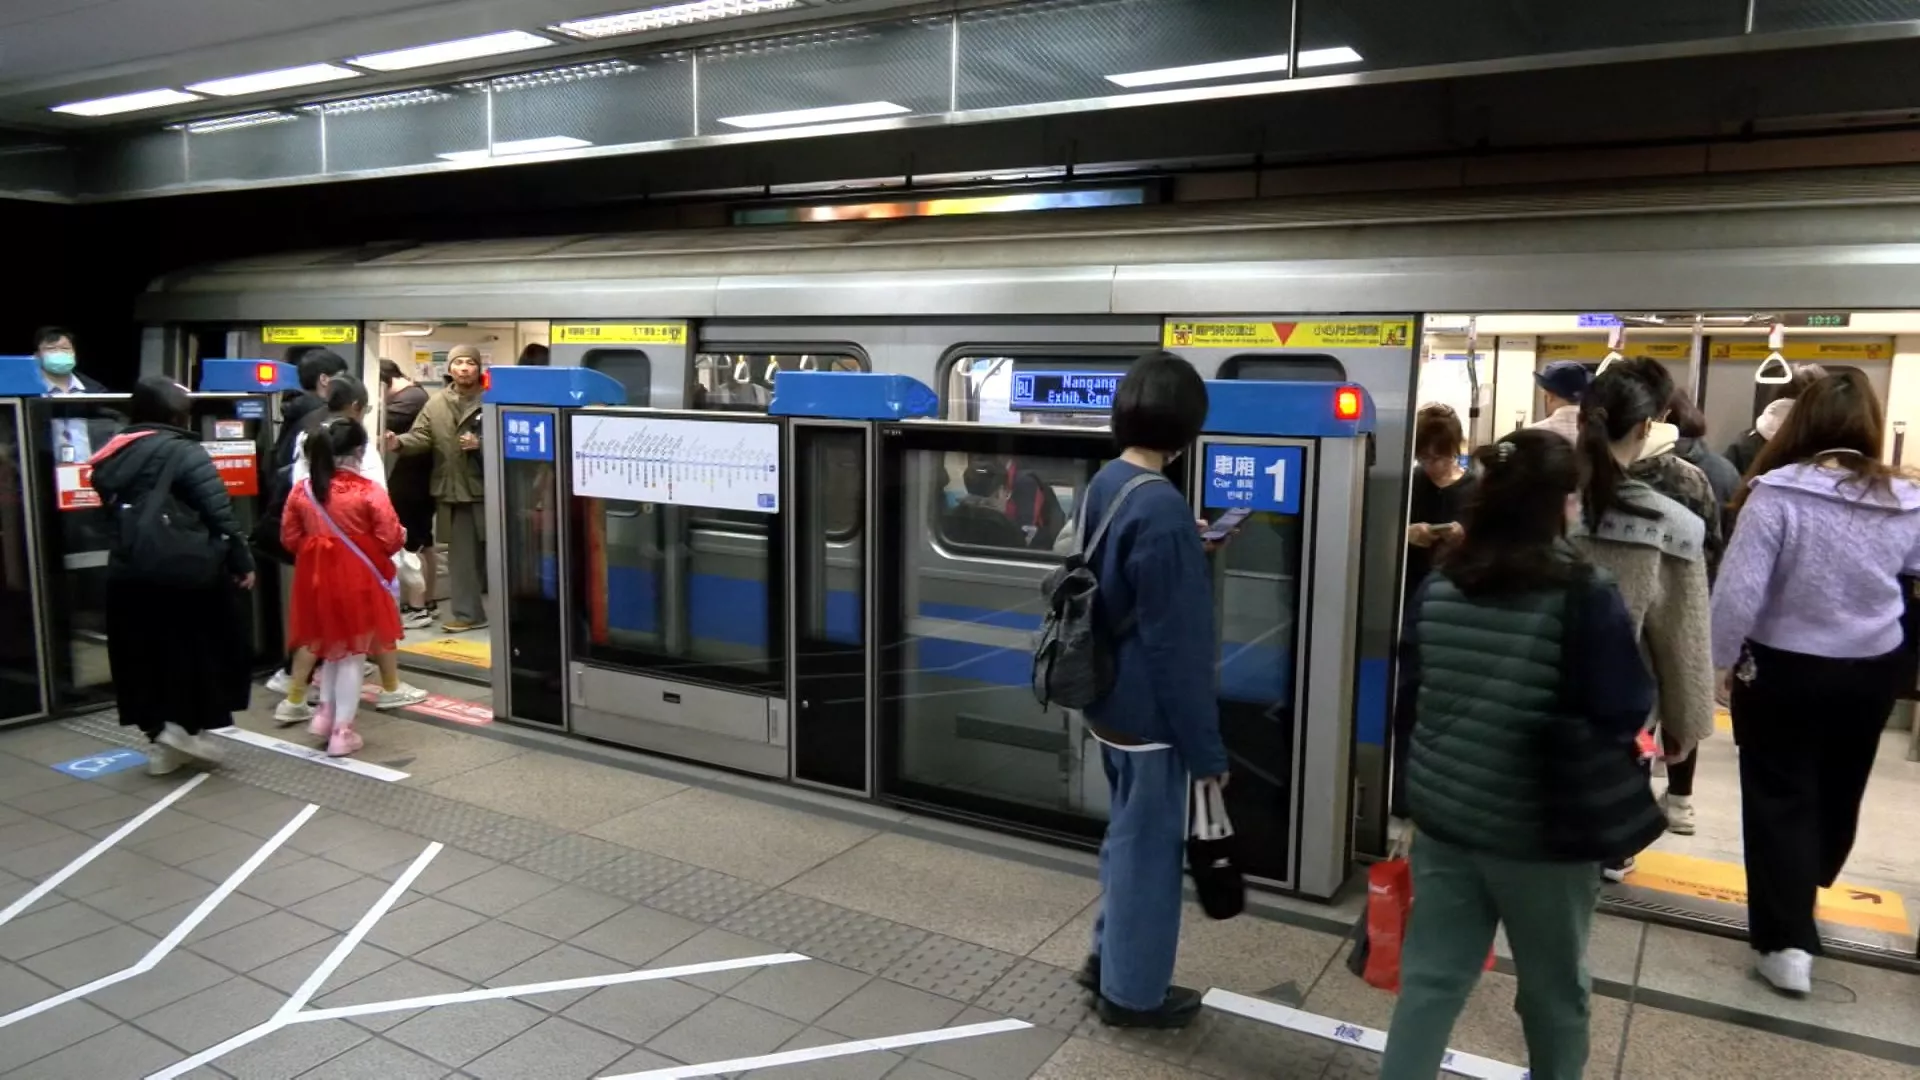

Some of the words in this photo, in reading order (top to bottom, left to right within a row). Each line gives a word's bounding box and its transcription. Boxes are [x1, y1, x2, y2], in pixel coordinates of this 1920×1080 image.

[1016, 380, 1032, 397] BL
[1063, 374, 1117, 392] Nangang
[534, 421, 546, 453] 1
[1214, 455, 1255, 477] 車廂
[1213, 477, 1232, 488] Car
[1265, 459, 1286, 502] 1
